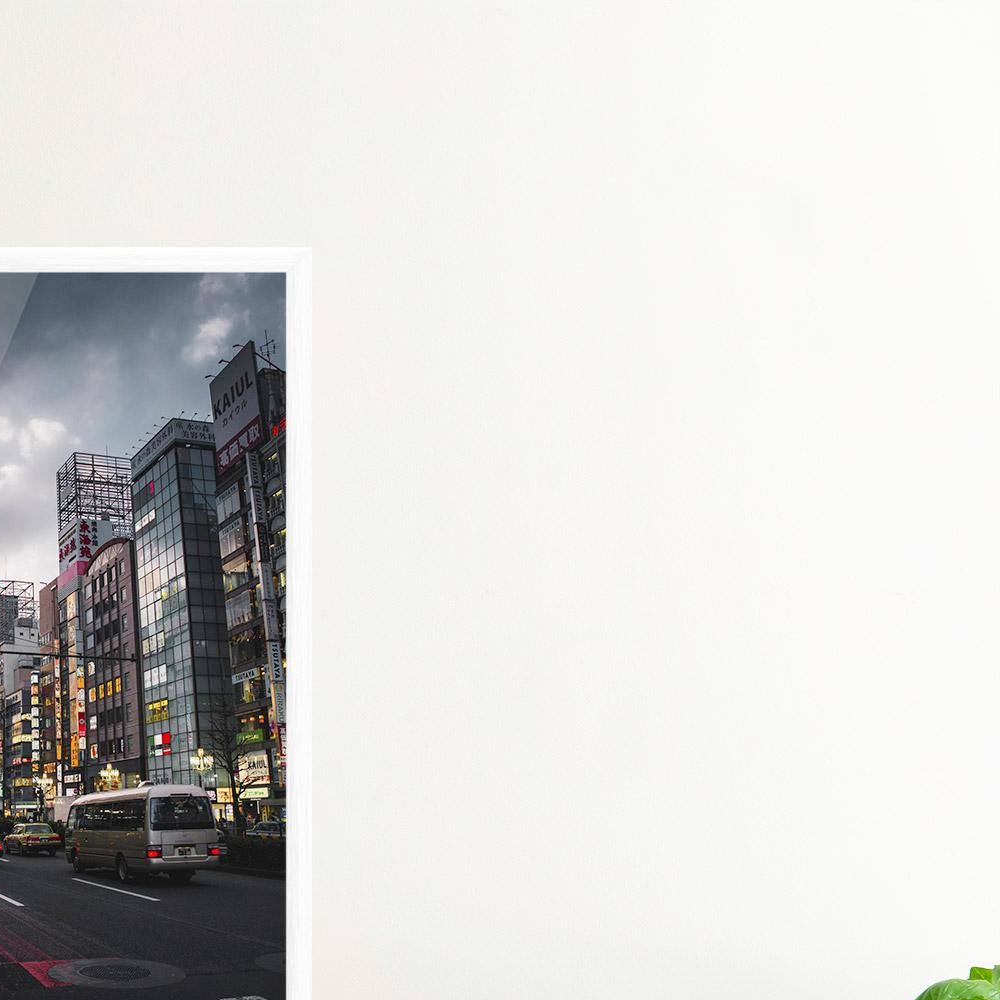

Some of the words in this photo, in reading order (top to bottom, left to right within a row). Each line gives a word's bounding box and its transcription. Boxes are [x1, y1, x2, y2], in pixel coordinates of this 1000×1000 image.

[213, 371, 253, 420] KAIUL
[235, 670, 255, 681] TSUTAYA
[272, 643, 281, 682] TSUTAYA
